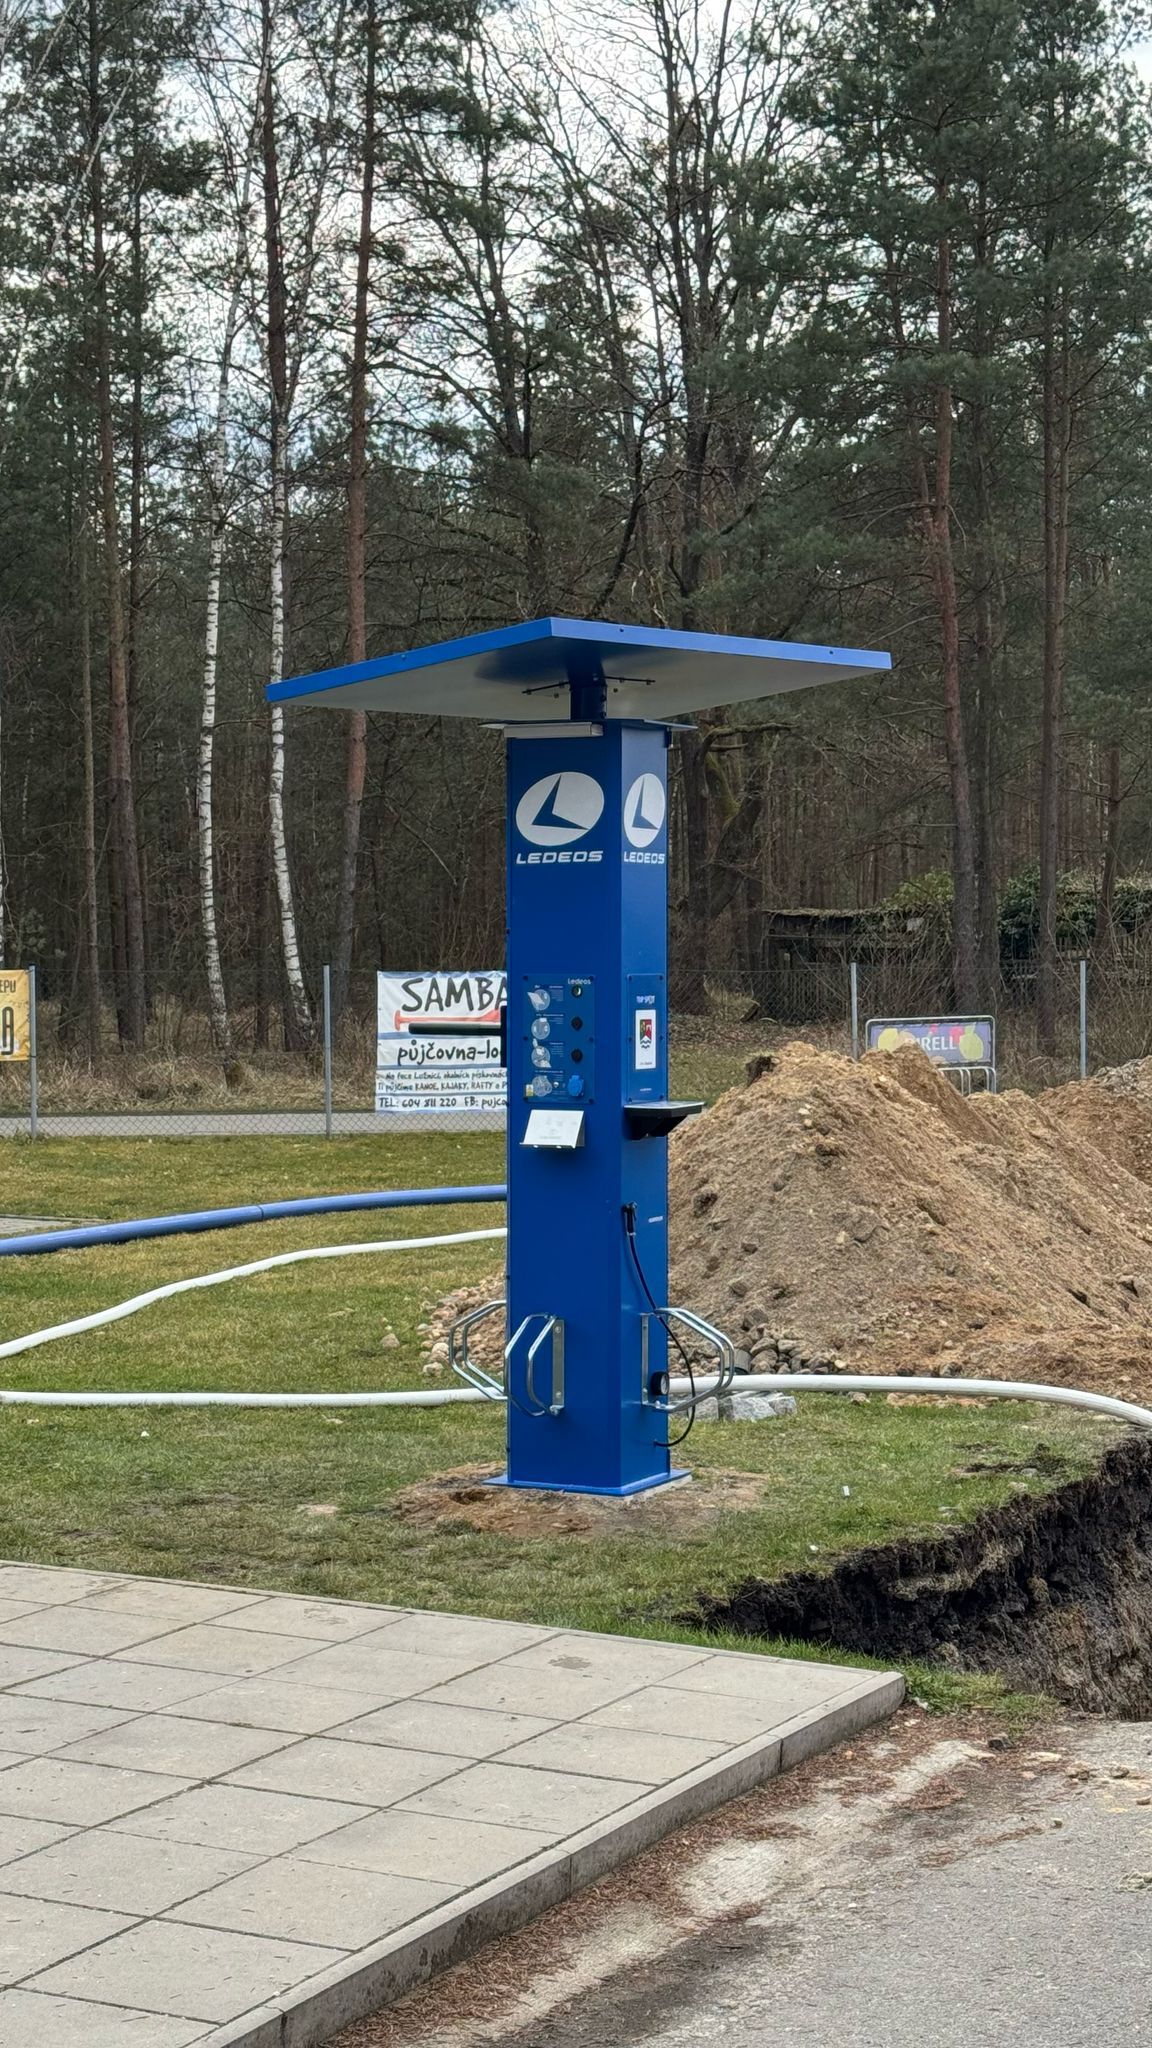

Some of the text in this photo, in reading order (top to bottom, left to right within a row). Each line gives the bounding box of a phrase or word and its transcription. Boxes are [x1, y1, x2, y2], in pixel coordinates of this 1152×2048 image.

[516, 850, 603, 865] LEDEOS
[623, 851, 665, 865] LEDEOS
[401, 977, 507, 1012] SAMBA
[401, 1099, 420, 1108] 604
[439, 1098, 457, 1108] 220
[464, 1096, 479, 1107] FB:
